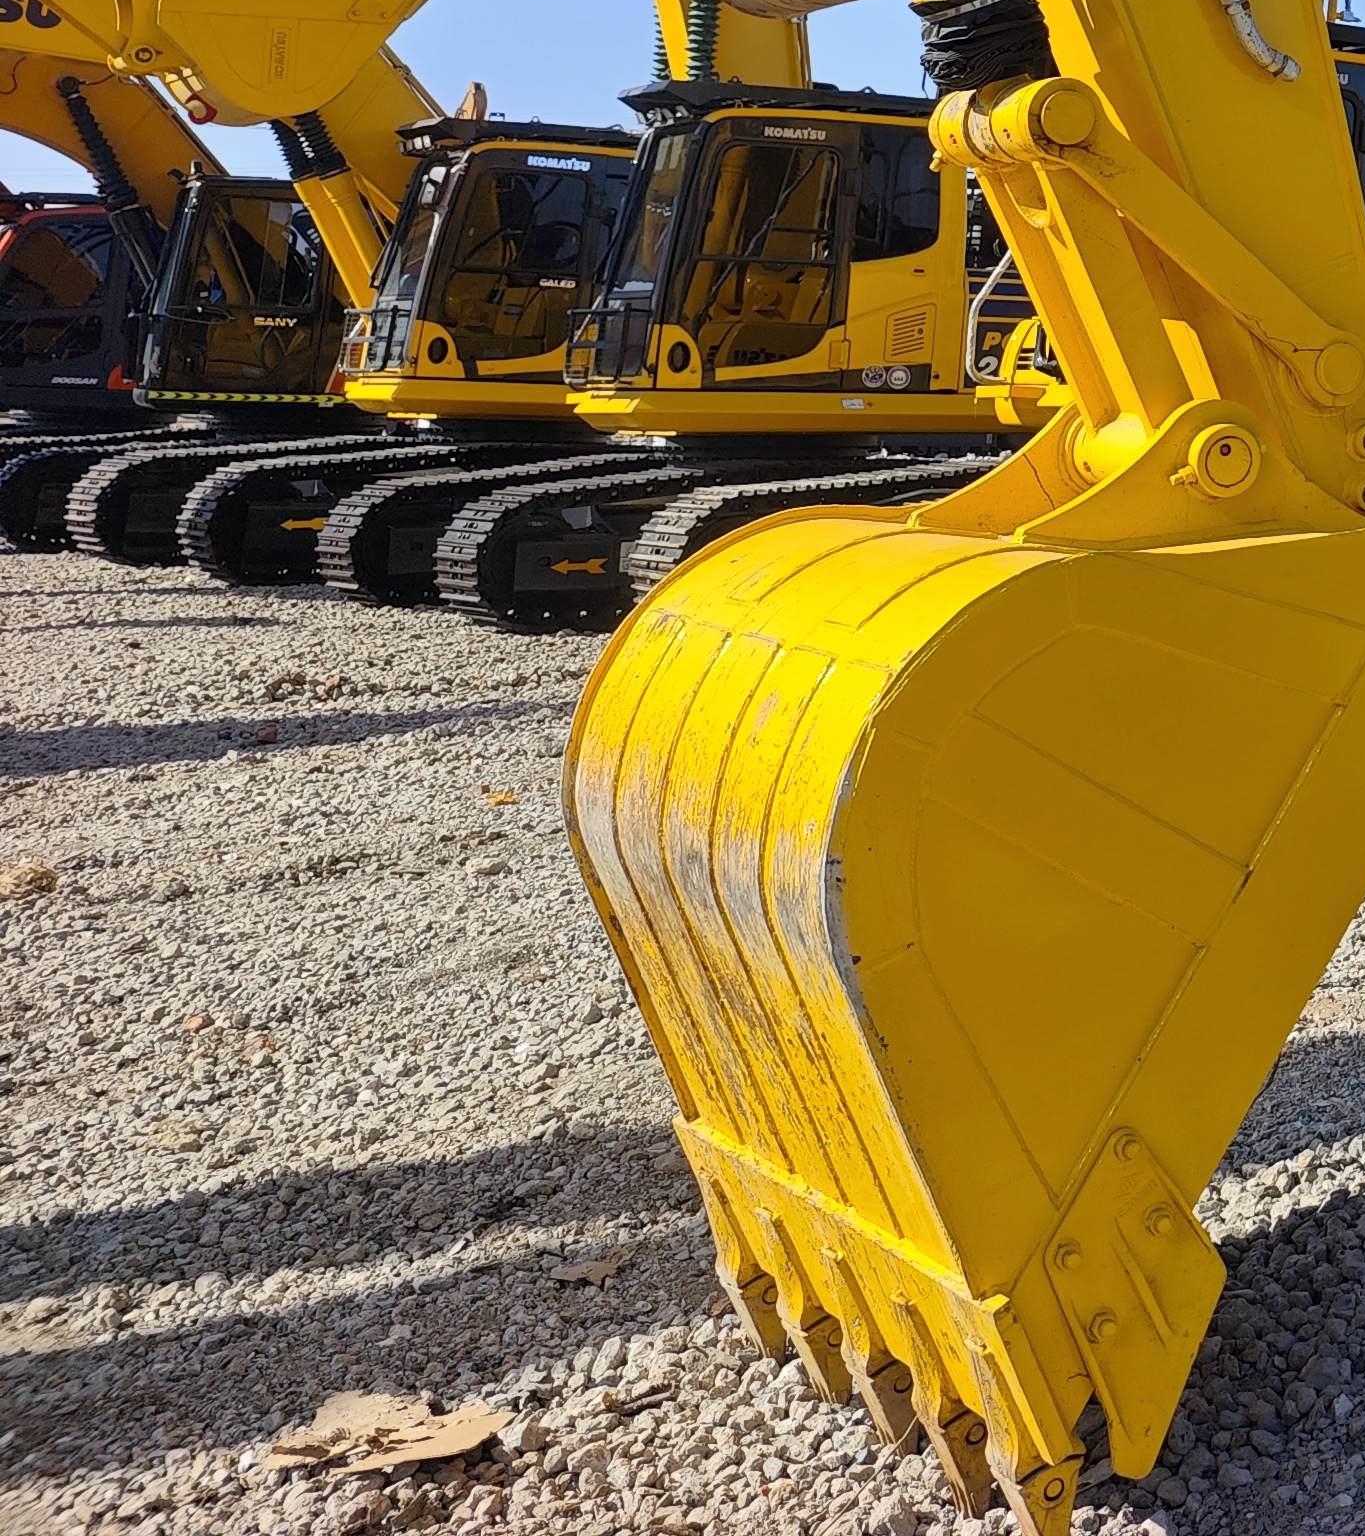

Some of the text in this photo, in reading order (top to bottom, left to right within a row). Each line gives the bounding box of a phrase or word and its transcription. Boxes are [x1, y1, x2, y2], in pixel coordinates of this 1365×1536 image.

[763, 126, 827, 141] KOMATSU
[527, 155, 592, 172] KOMATSU
[254, 316, 298, 328] SANY
